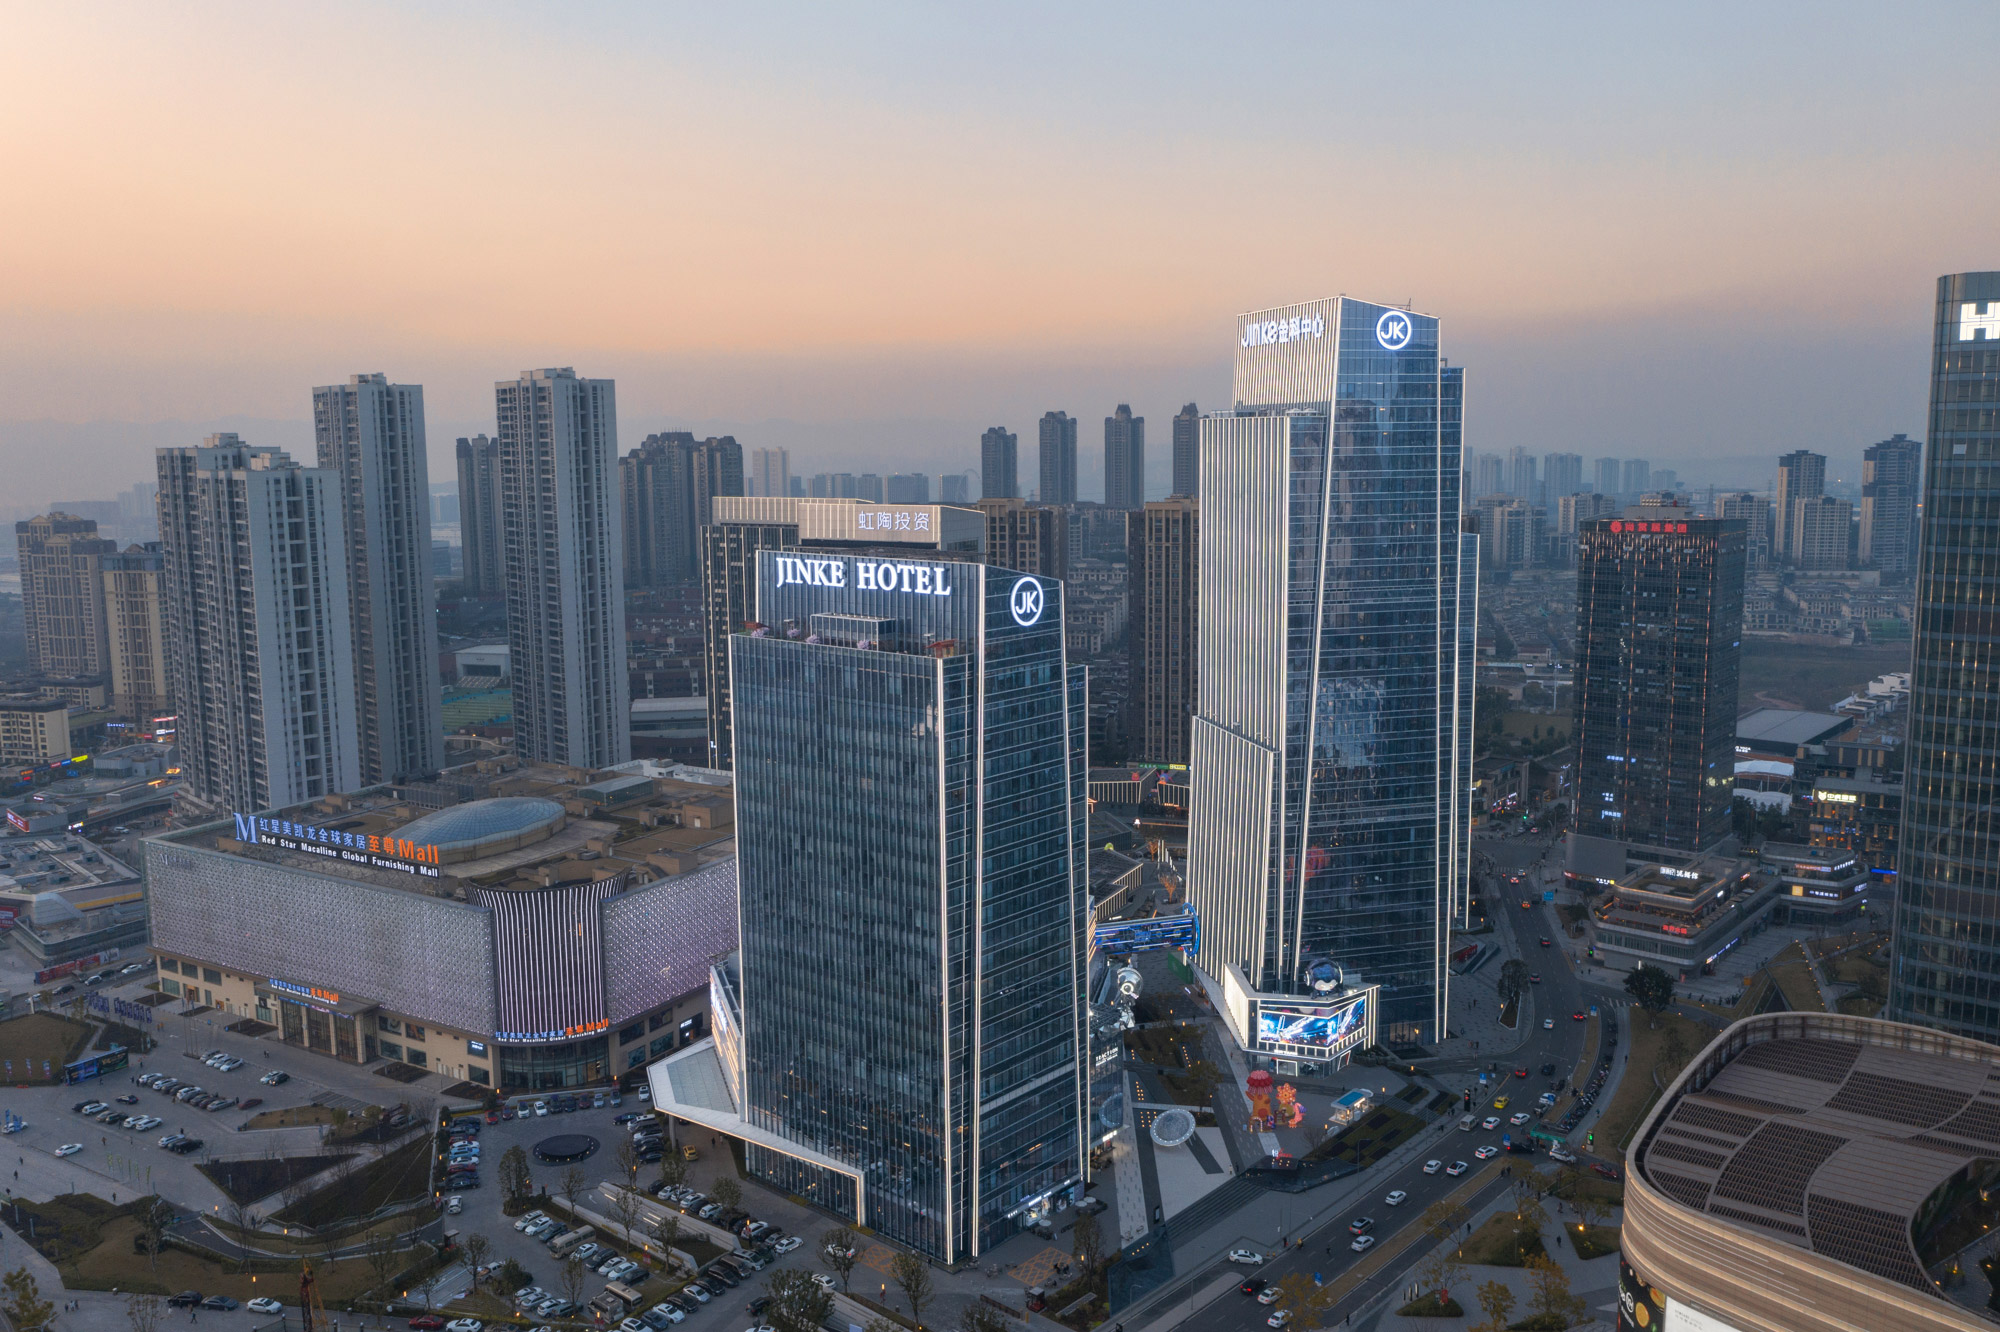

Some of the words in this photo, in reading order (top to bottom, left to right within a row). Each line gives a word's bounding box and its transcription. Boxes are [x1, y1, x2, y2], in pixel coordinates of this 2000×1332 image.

[858, 510, 930, 531] 虹陶投资
[776, 557, 845, 588] JINKE
[856, 562, 951, 596] HOTEL
[261, 835, 276, 845] Red
[280, 839, 297, 849] Star
[301, 842, 337, 858] Macalline
[342, 850, 368, 864] Global
[372, 857, 415, 875] Furnishing
[420, 865, 439, 878] Mall
